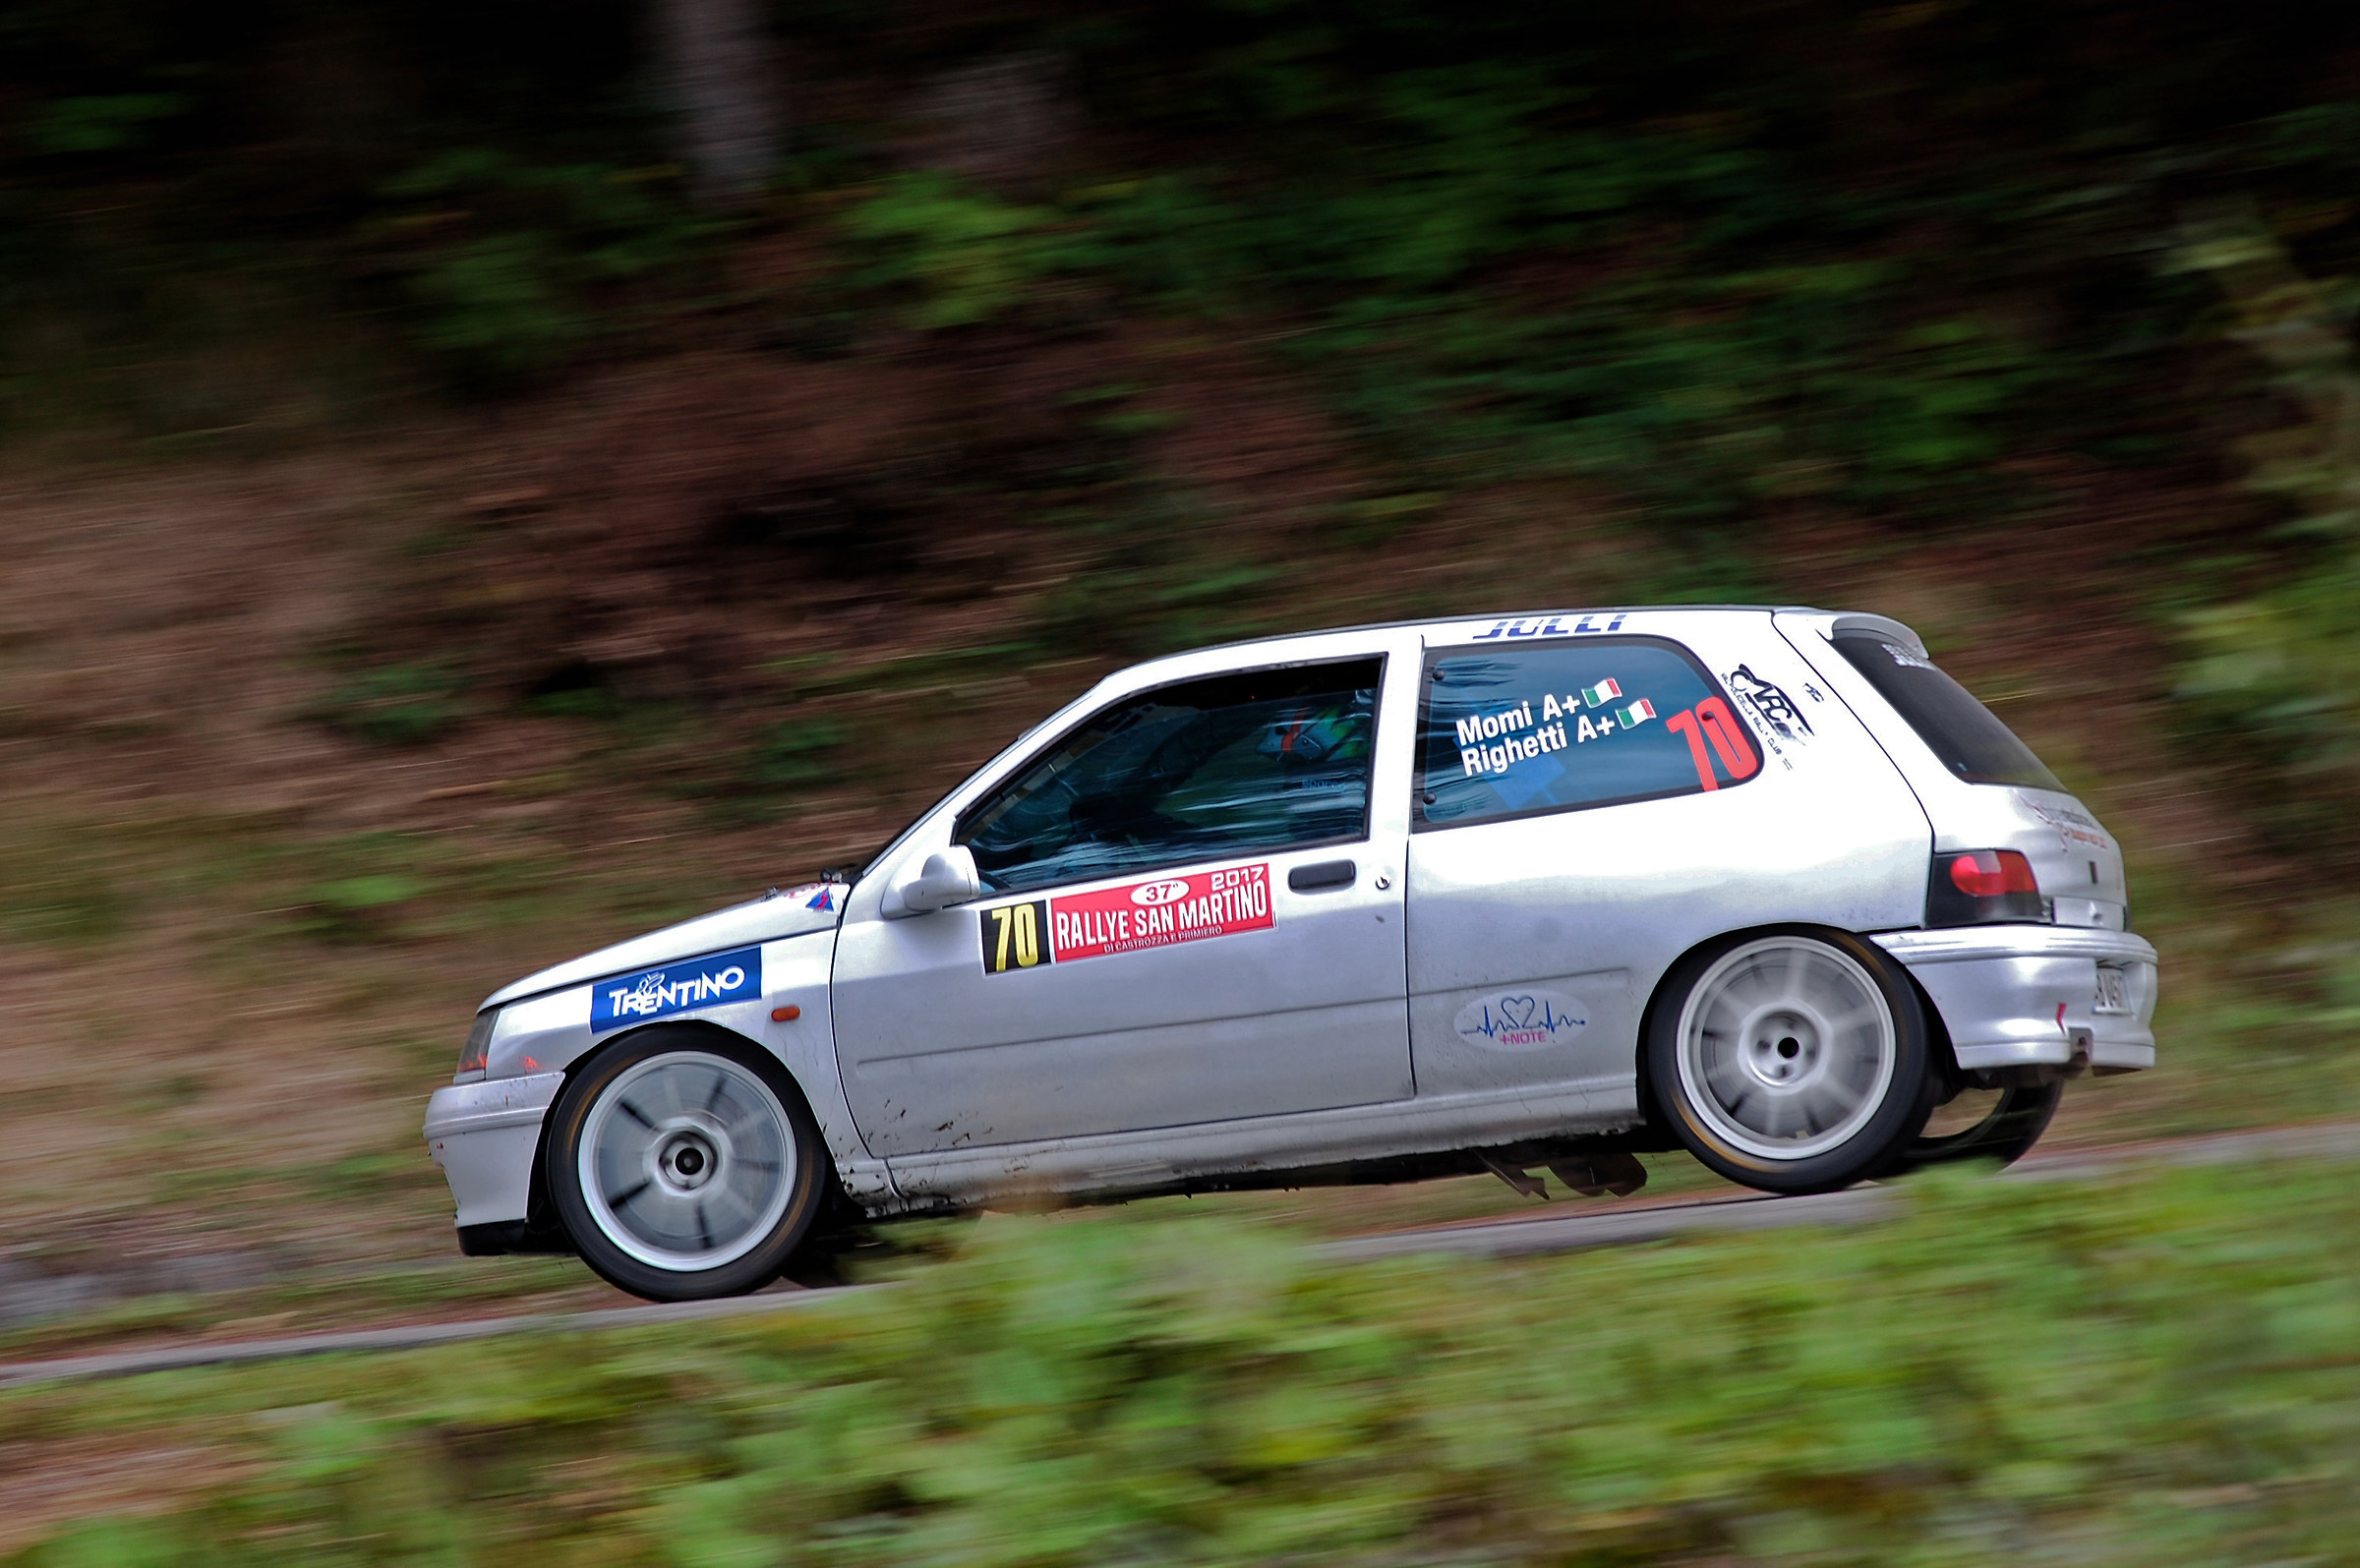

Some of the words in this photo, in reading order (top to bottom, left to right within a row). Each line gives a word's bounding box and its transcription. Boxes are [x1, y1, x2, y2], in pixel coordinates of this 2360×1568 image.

[1455, 700, 1533, 747] Momi
[1543, 693, 1581, 722] A+
[1460, 722, 1567, 777] Righetti
[1577, 715, 1616, 743] A+
[1665, 696, 1757, 792] 70
[1210, 866, 1265, 892] 2017
[991, 903, 1039, 972] 70
[1056, 910, 1130, 951] RALLYE
[1134, 904, 1174, 937] SAN
[1178, 879, 1268, 930] MARTINO
[1104, 943, 1114, 953] DI
[1116, 933, 1169, 952] CASTROZZA
[1179, 925, 1222, 941] PRIMIERO
[608, 965, 745, 1016] TRENTINO
